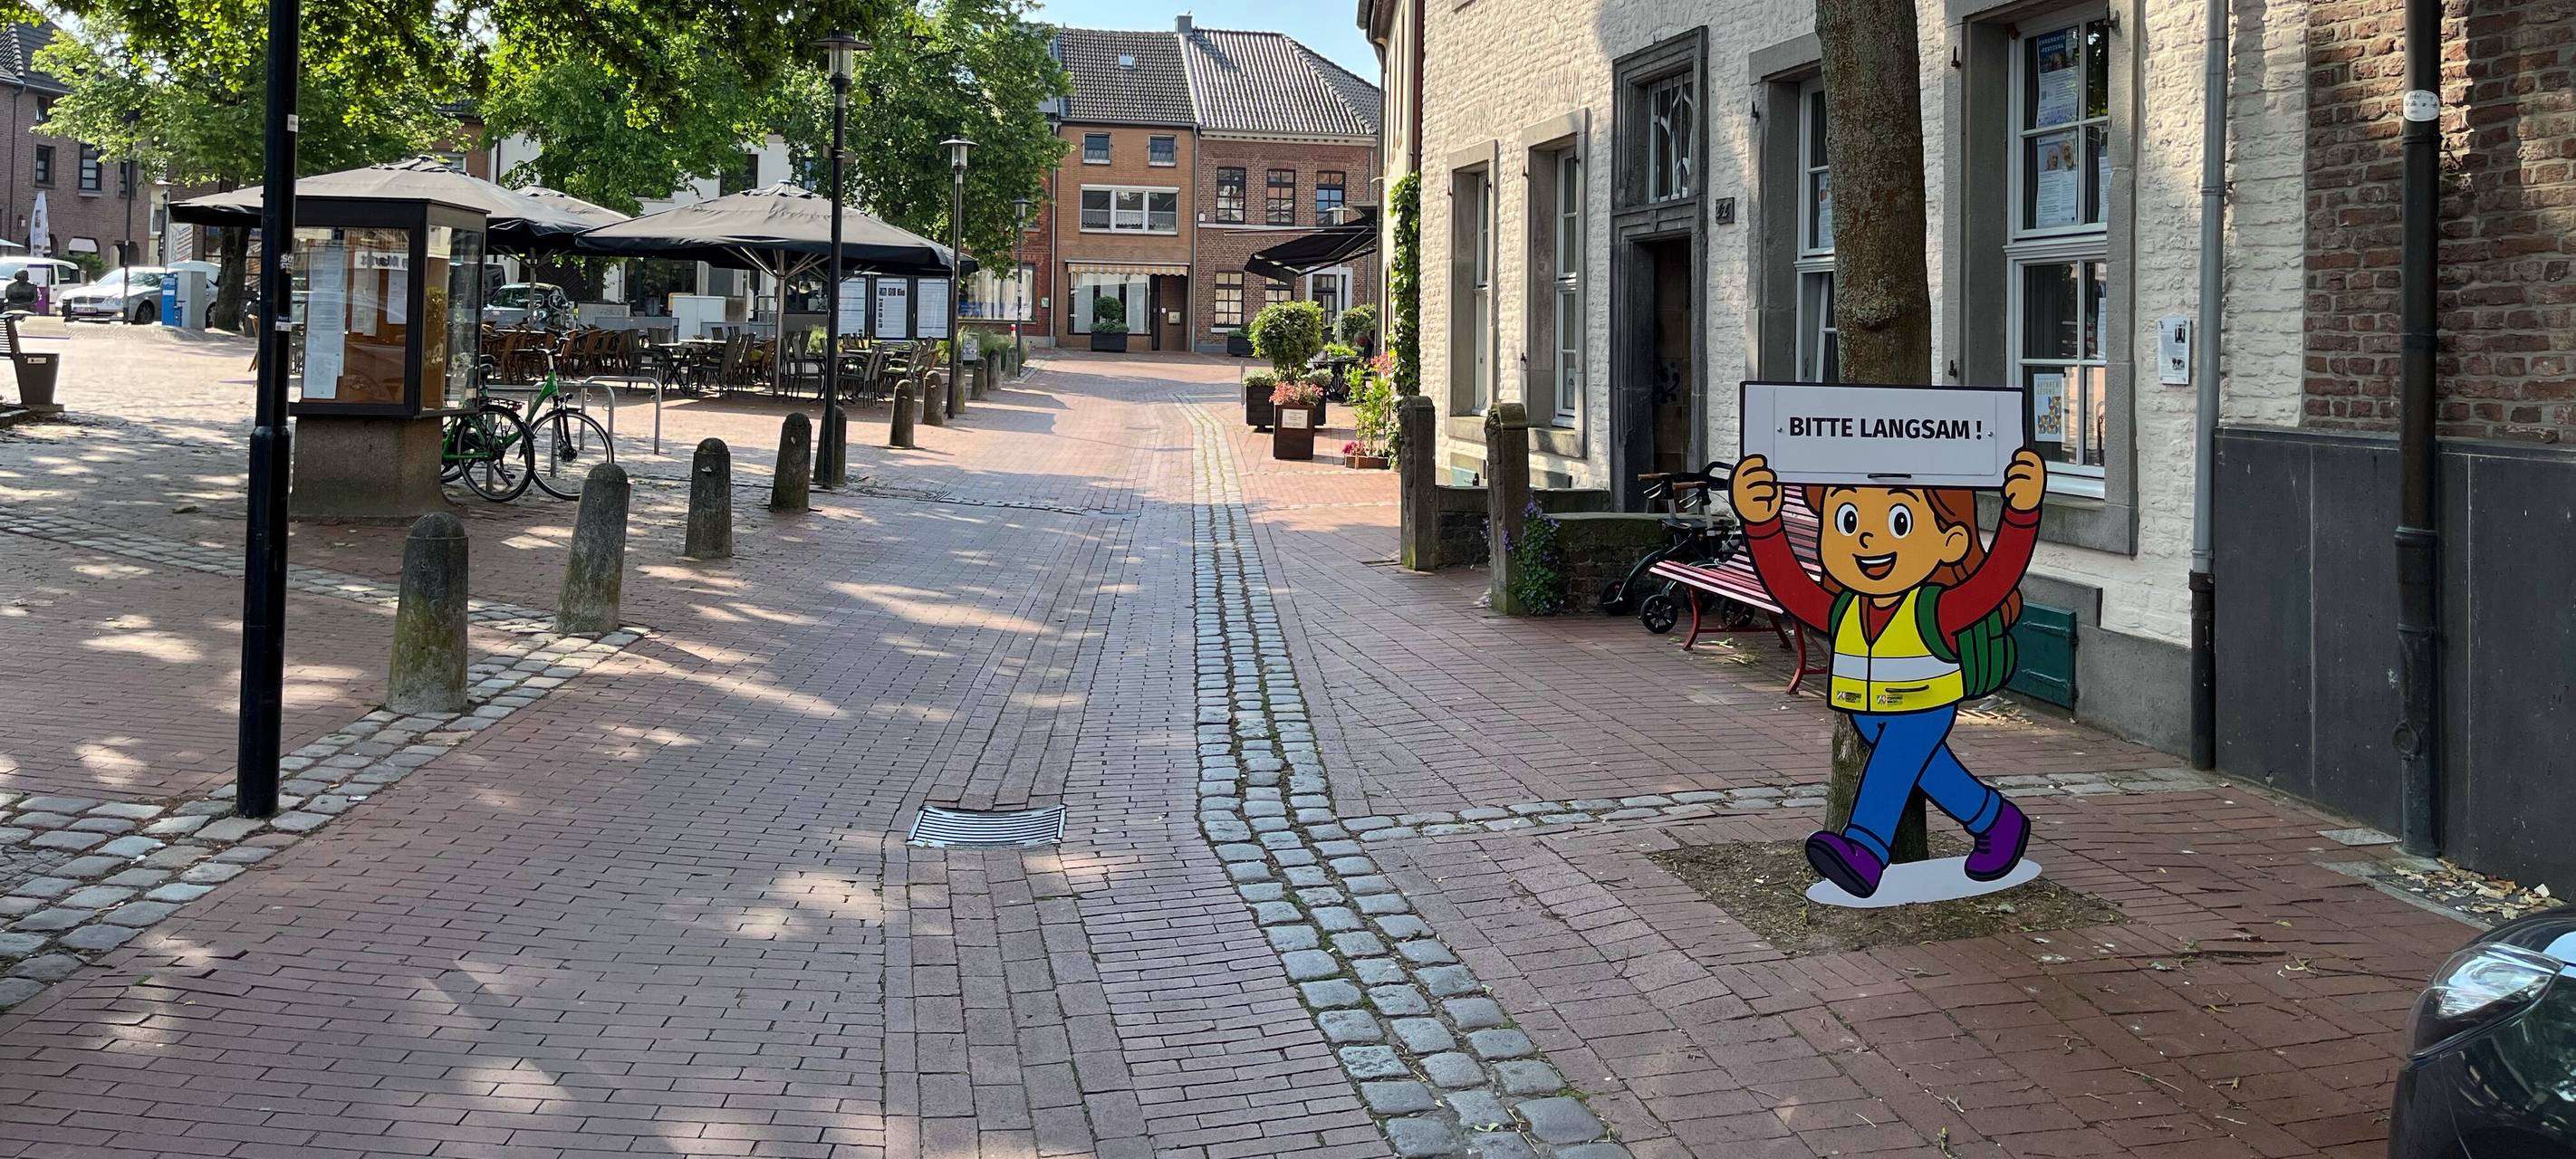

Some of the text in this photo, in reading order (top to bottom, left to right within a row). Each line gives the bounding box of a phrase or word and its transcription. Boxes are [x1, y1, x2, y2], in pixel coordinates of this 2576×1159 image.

[1789, 417, 1982, 440] BITTE LANGSAM !
